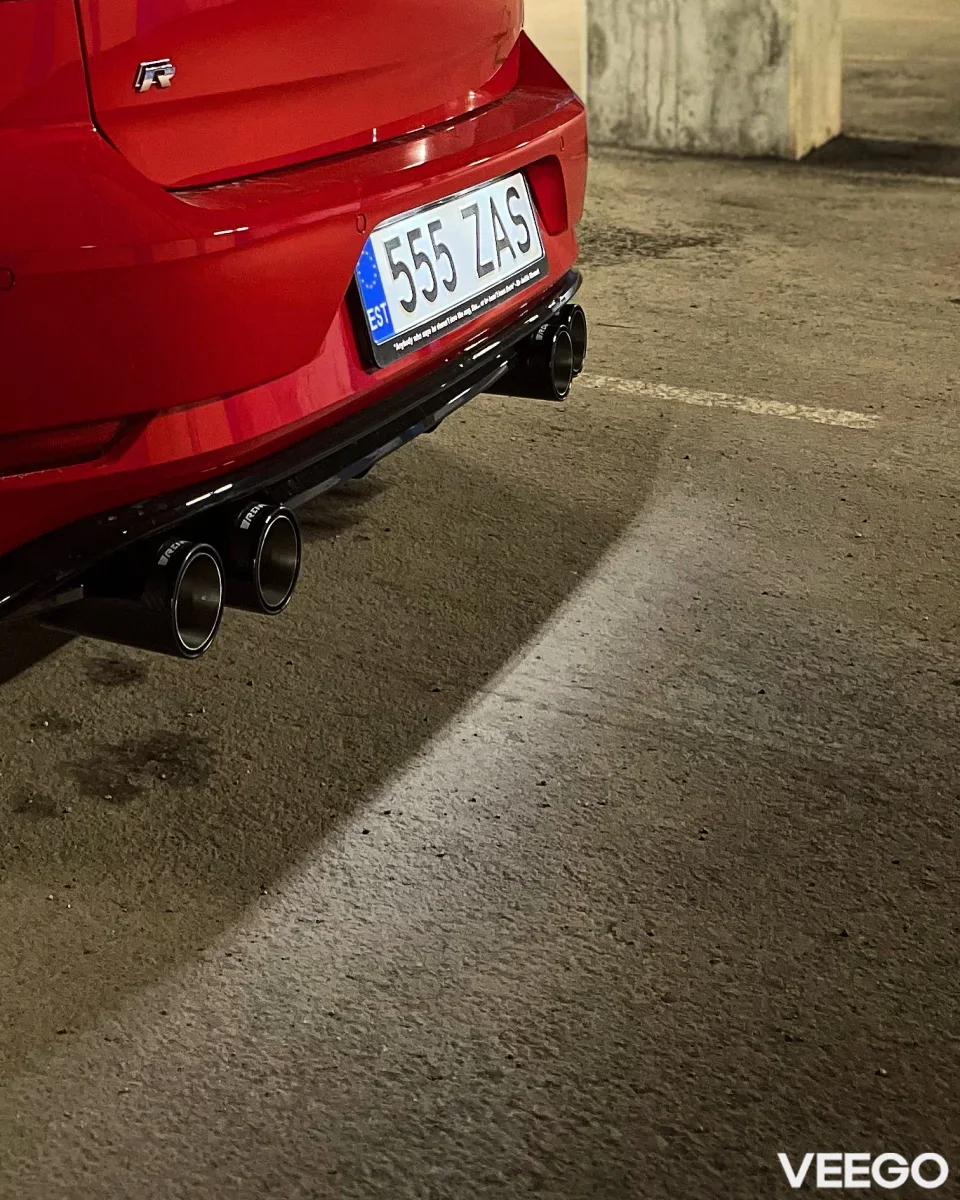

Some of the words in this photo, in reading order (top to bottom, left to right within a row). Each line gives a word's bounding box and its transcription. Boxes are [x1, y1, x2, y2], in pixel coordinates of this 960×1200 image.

[135, 58, 175, 93] R
[384, 220, 457, 312] 555
[461, 187, 531, 278] ZAS
[368, 303, 389, 330] EST
